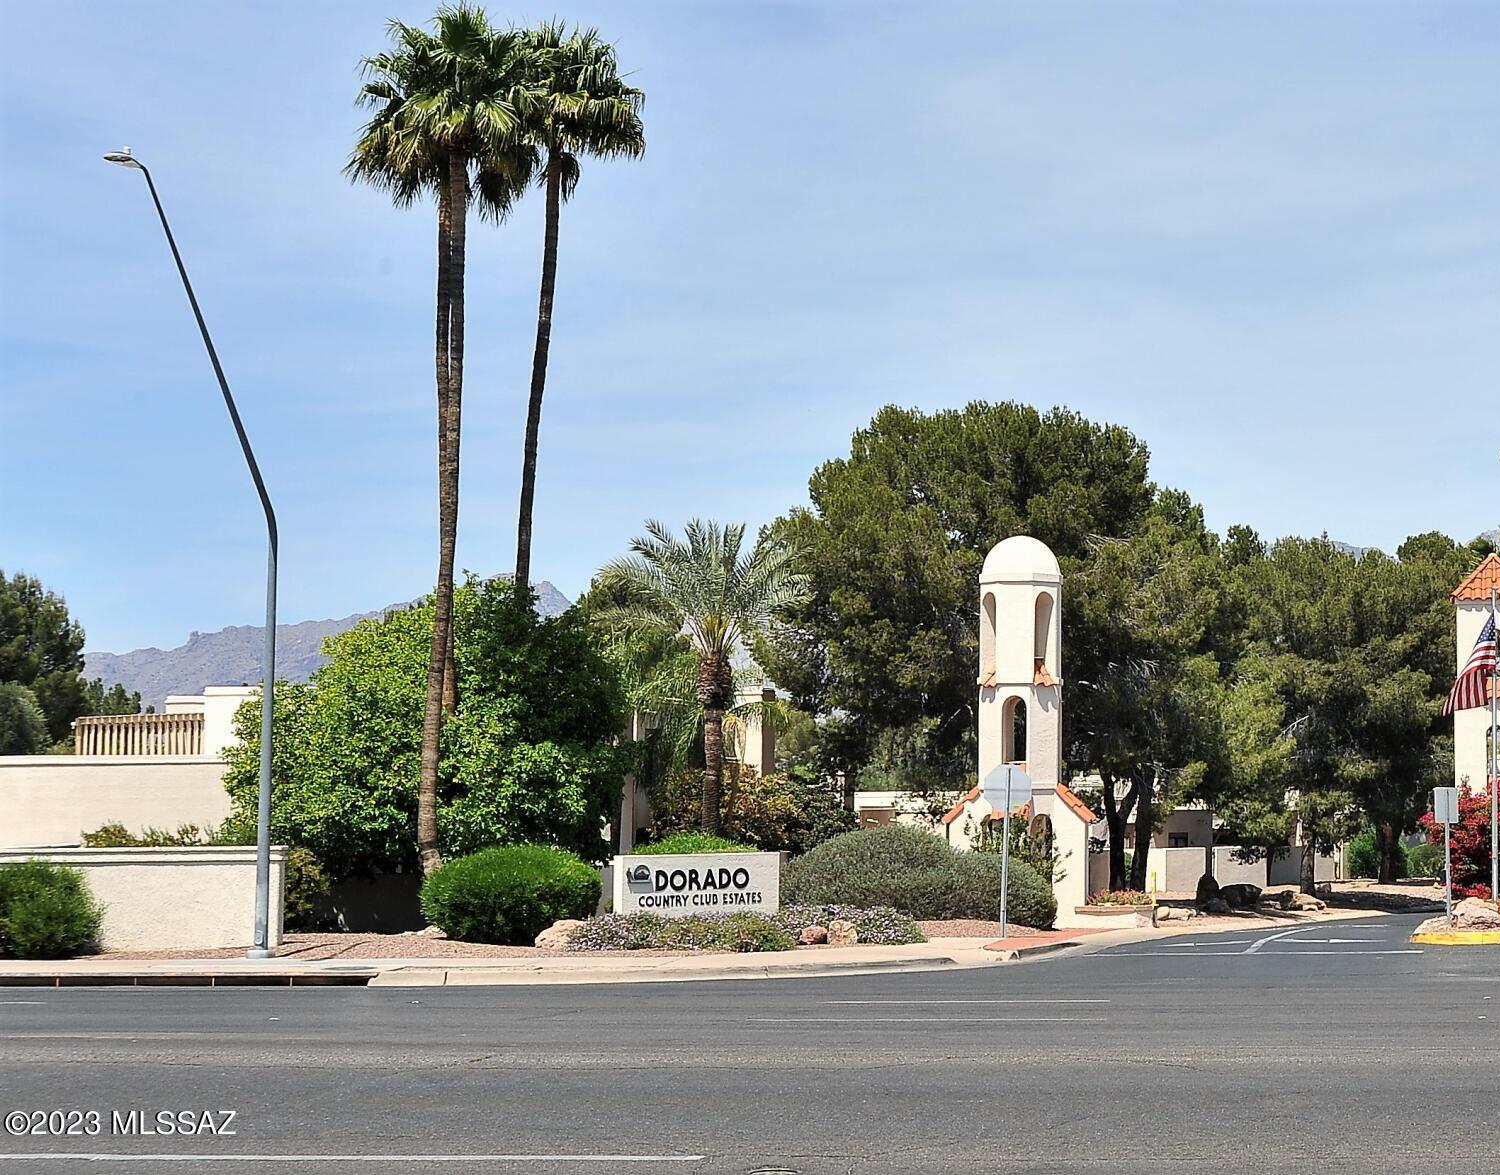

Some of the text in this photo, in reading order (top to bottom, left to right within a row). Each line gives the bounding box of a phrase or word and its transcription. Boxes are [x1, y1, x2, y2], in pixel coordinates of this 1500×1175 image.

[655, 867, 750, 891] DORADO
[638, 891, 762, 909] COUNTRY CLUB ESTATES
